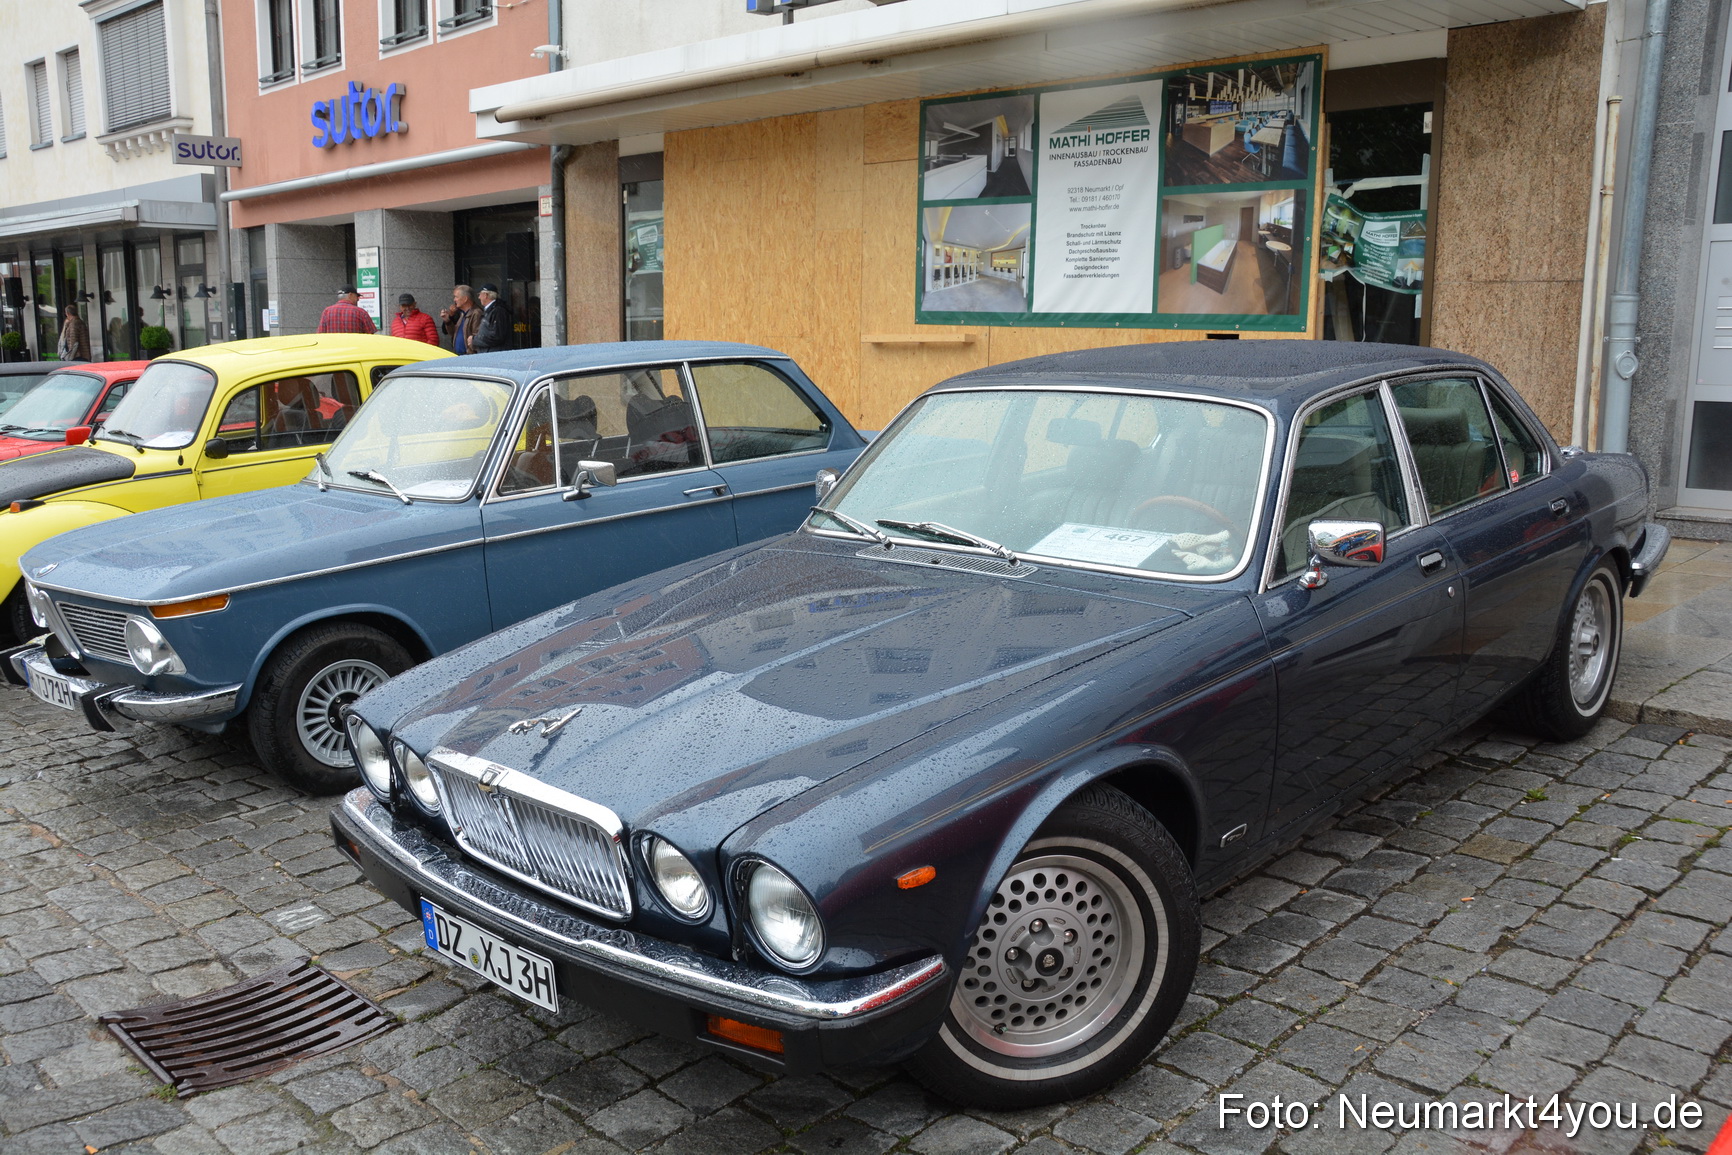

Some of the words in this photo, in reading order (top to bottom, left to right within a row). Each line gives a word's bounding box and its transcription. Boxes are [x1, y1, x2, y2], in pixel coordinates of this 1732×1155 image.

[1095, 128, 1150, 146] HOFFER
[177, 140, 241, 162] sutor.
[1049, 150, 1098, 160] INNENAUSBAU
[1103, 146, 1149, 157] TROCKENBAU
[1073, 157, 1123, 168] FASSADENBAU
[1085, 185, 1111, 193] Neumarkt
[1102, 193, 1121, 201] 460170
[1069, 203, 1120, 212] www.mathi-hoffer.de
[1066, 231, 1095, 239] Brandschutz
[1104, 532, 1146, 544] 467
[434, 912, 467, 961] DZ
